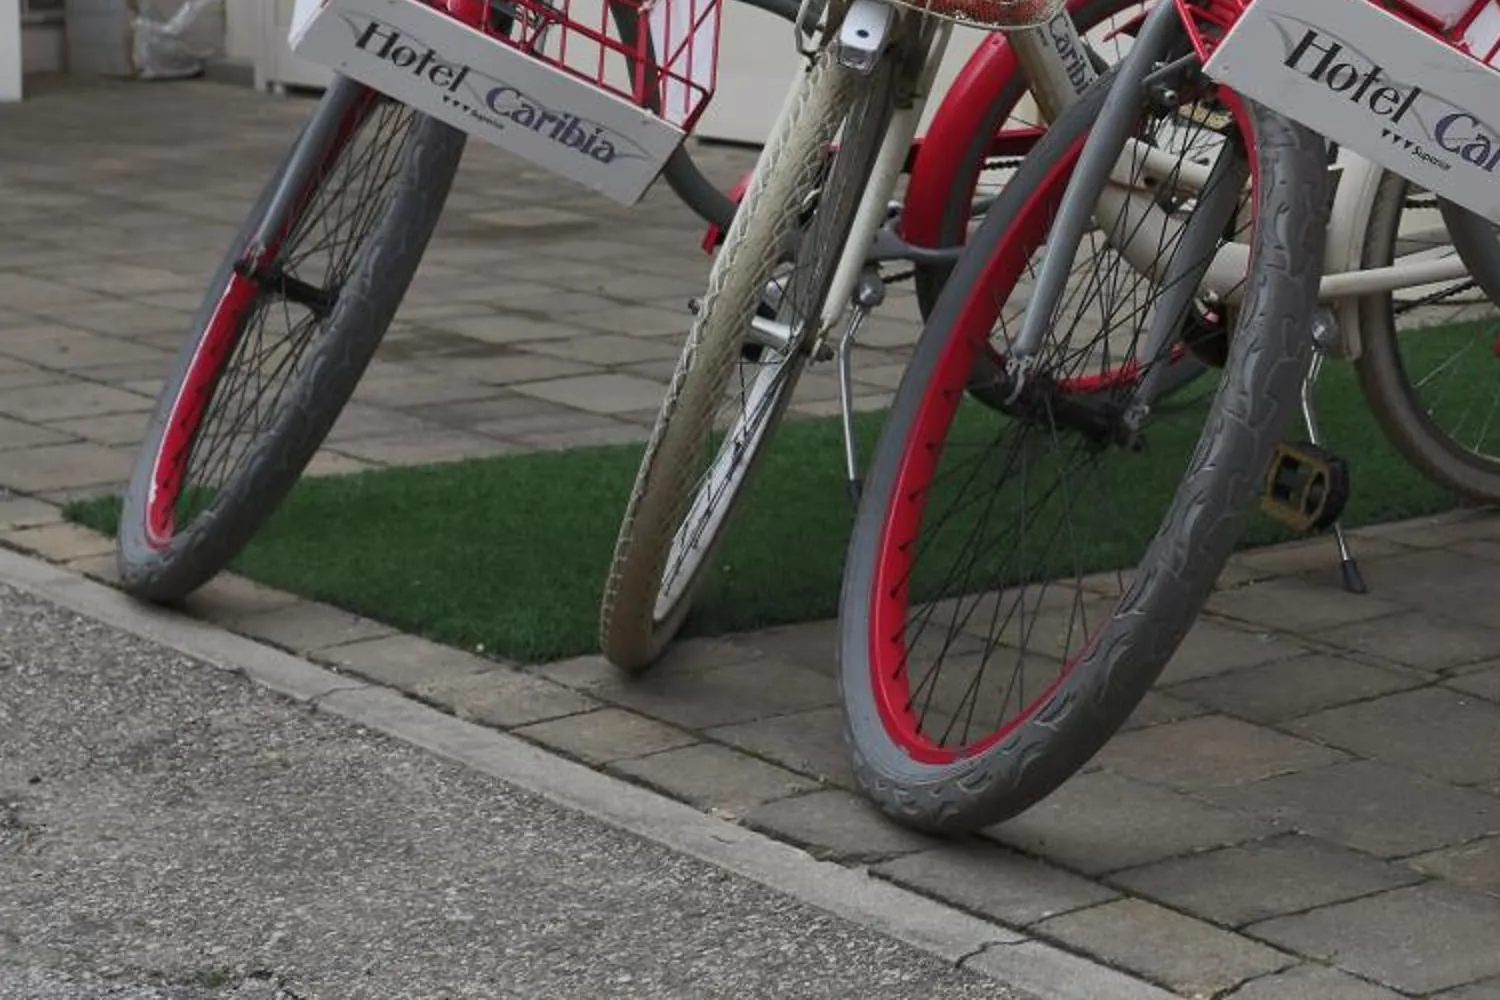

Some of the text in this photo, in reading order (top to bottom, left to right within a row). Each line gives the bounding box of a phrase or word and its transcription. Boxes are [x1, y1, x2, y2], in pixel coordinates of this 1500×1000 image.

[355, 21, 616, 164] Hotel Caribia
[1049, 10, 1094, 96] Caribi
[1283, 29, 1423, 124] Hotel
